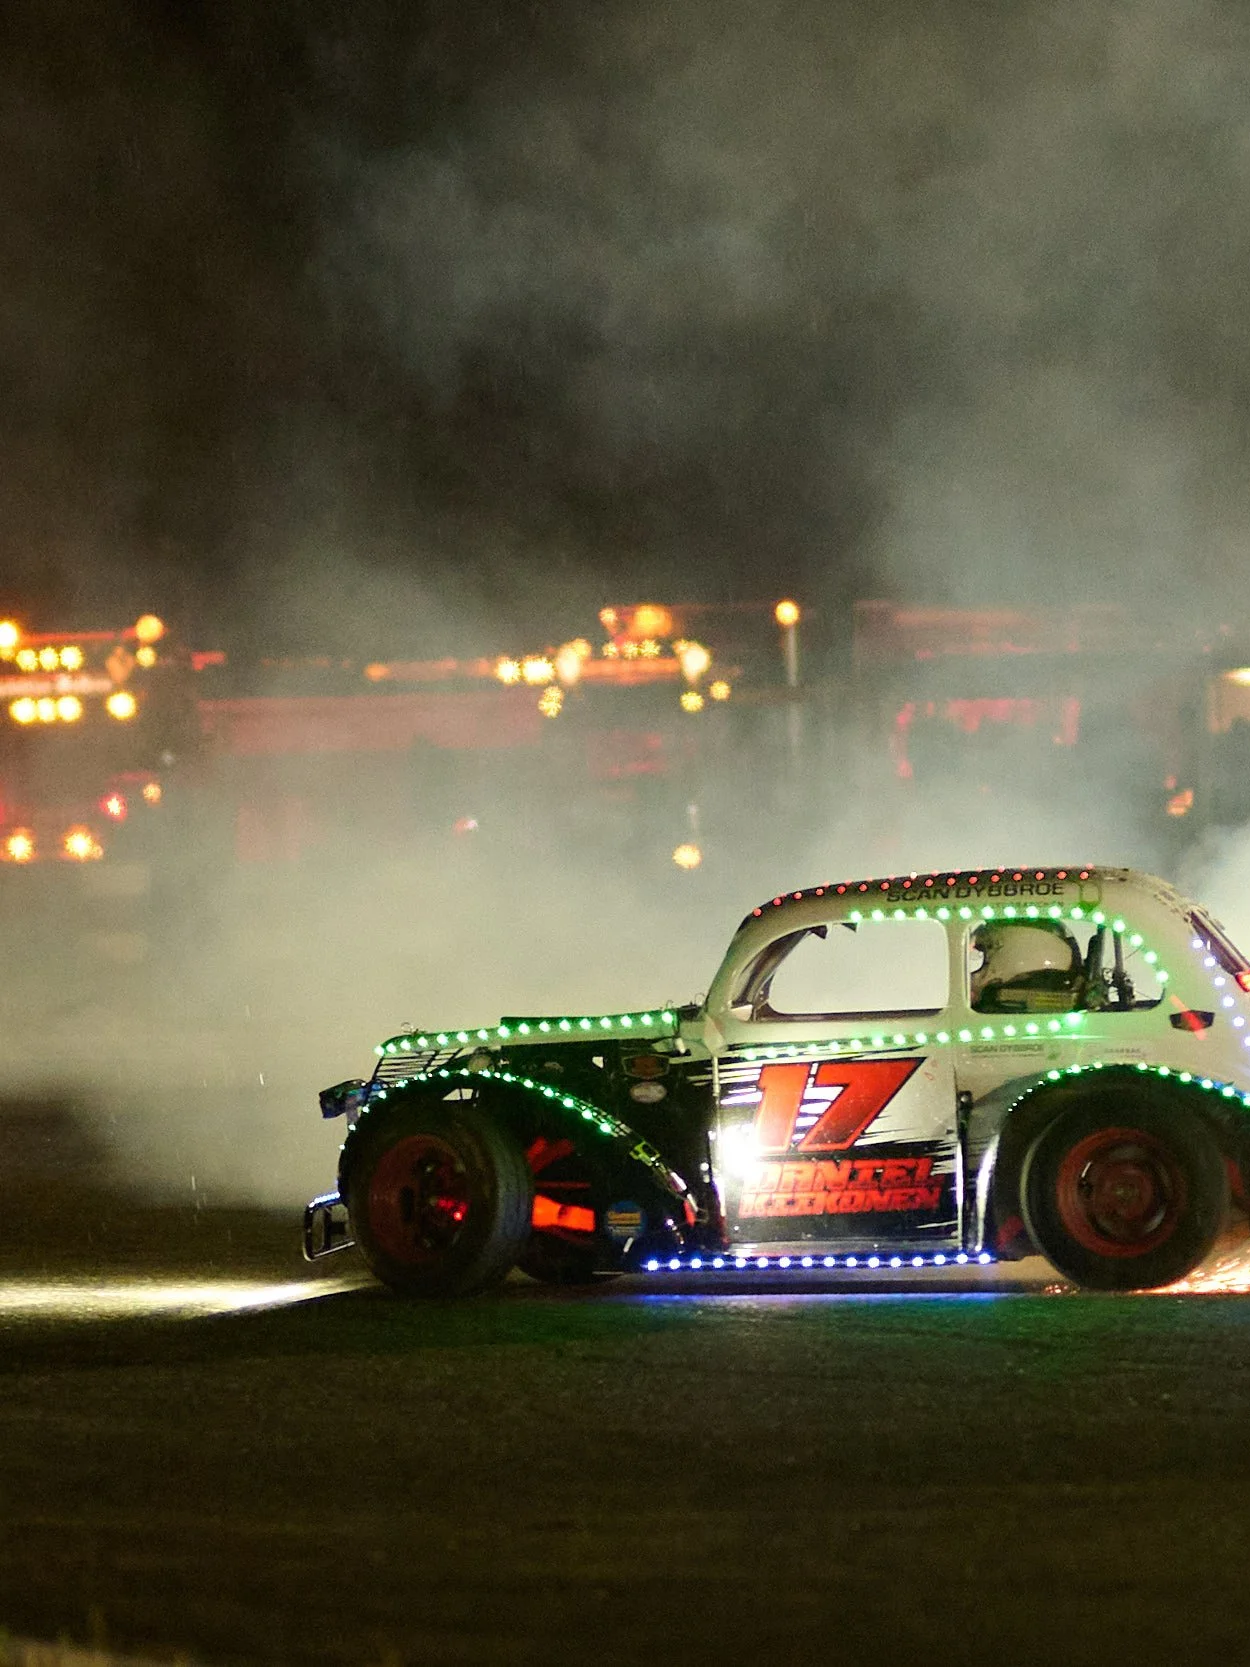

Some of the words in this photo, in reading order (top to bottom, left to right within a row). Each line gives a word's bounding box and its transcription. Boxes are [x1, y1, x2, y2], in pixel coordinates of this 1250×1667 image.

[886, 888, 949, 902] SCAN
[954, 882, 1065, 900] DYBBROE
[756, 1057, 928, 1151] 17
[743, 1157, 943, 1193] DANIEL
